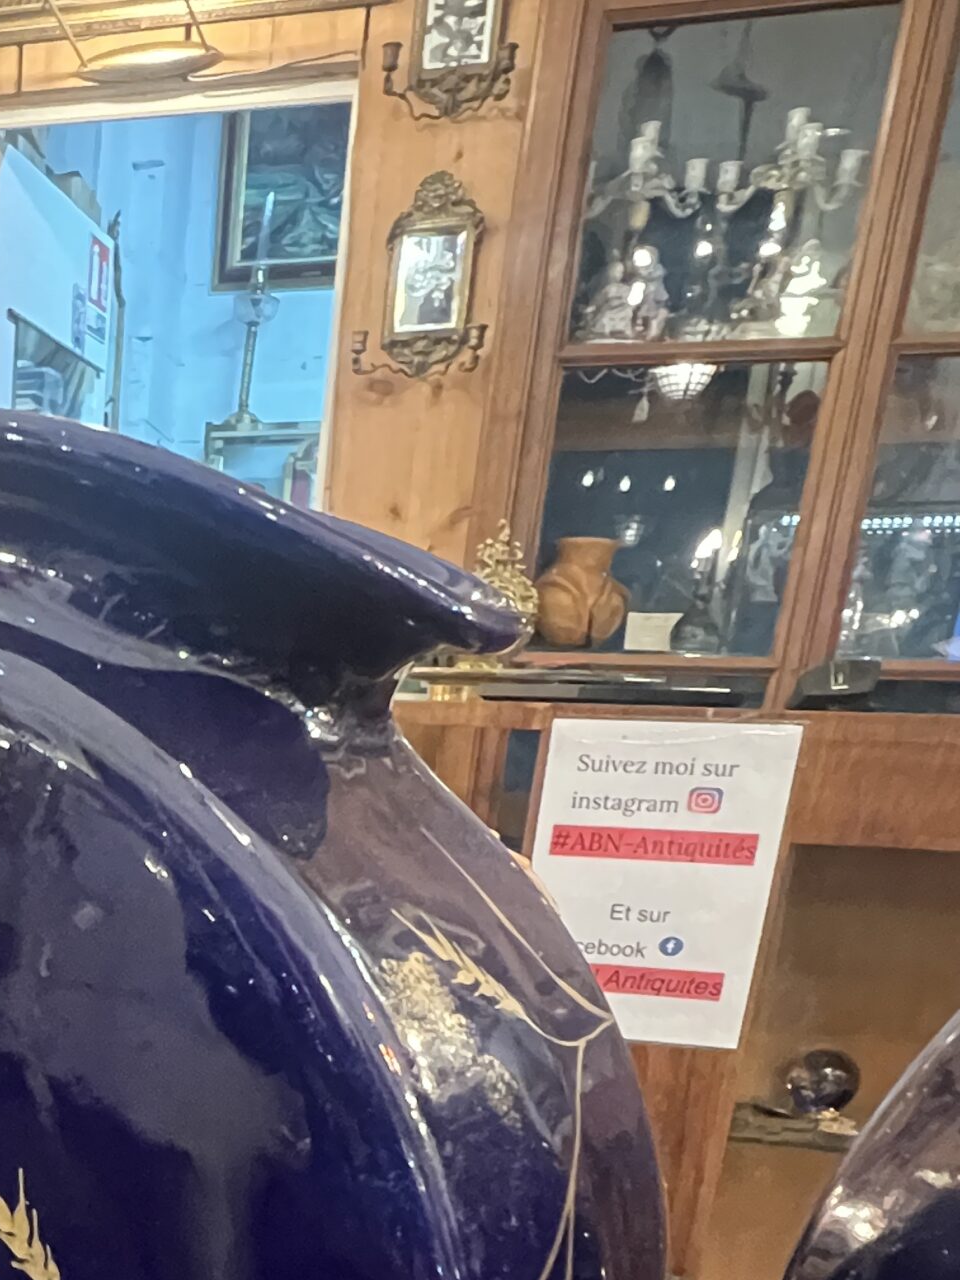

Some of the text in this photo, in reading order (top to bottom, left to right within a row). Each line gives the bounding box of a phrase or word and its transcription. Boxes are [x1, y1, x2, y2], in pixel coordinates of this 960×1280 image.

[576, 753, 740, 778] Suivez moi sur
[570, 791, 679, 818] instagram
[609, 903, 672, 923] Et sur
